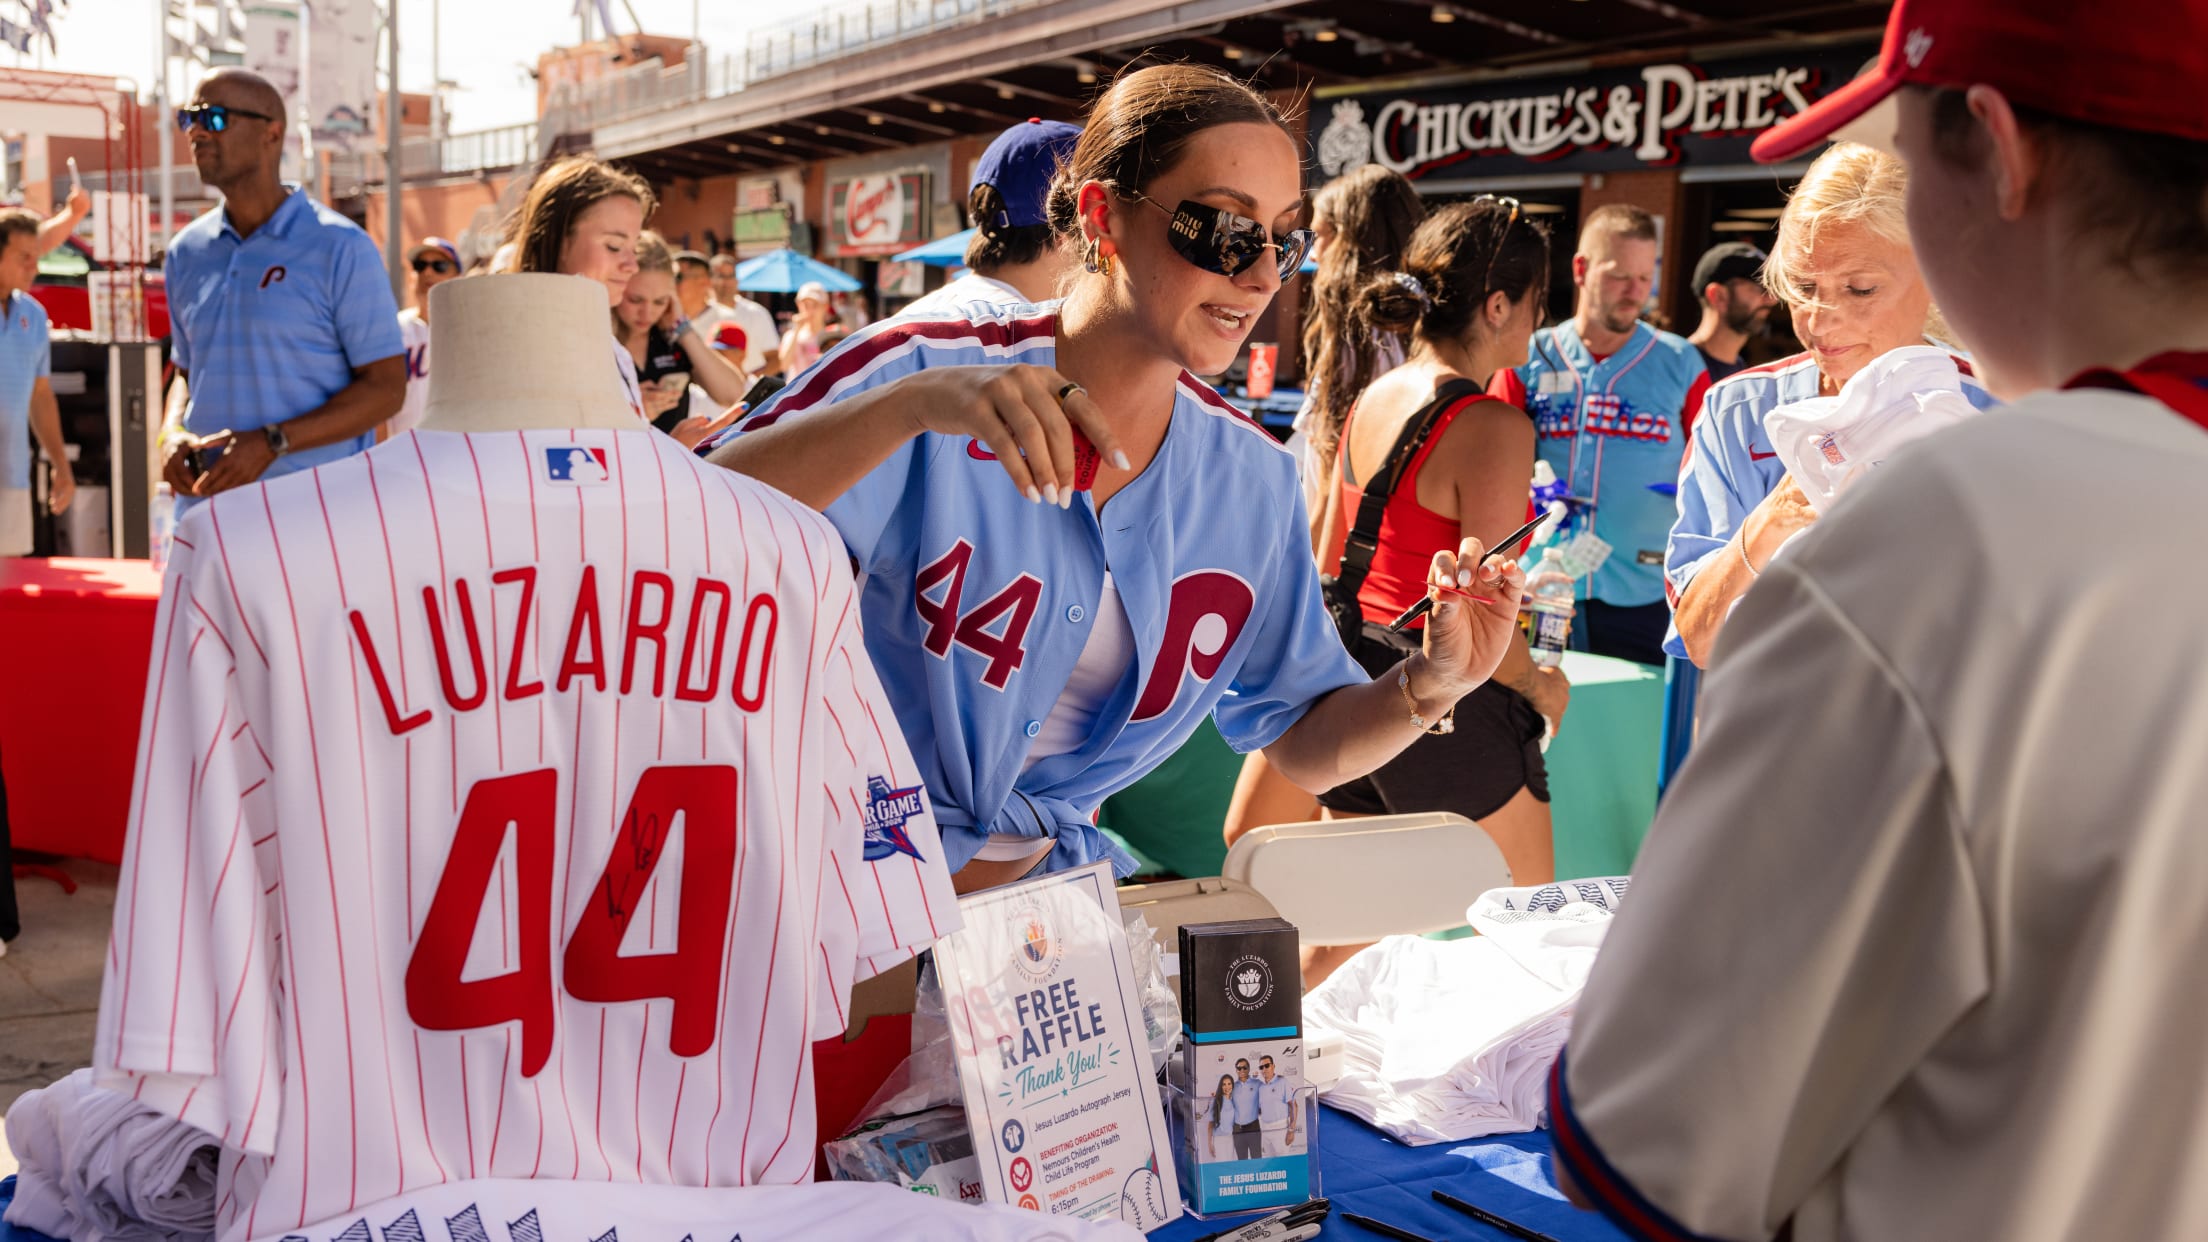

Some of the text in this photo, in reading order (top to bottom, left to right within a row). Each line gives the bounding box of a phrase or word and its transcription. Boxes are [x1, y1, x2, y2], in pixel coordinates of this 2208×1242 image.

[1602, 85, 1642, 147] &
[915, 533, 1044, 692] 44
[349, 564, 779, 736] LUZARDO
[1129, 568, 1256, 724] P
[876, 793, 920, 821] GAME
[405, 764, 738, 1079] 44
[1229, 954, 1269, 970] THE LUZARDO
[1014, 978, 1080, 1026] FREE
[1224, 984, 1275, 1011] FAMILY FOUNDATION
[997, 1003, 1106, 1070] RAFFLE
[1016, 1042, 1102, 1099] Thank You!
[1034, 1088, 1131, 1133] Jesus Luzardo Autograph Jersey
[1040, 1122, 1119, 1160] BENEFITING ORGANIZATION:
[1042, 1134, 1121, 1173] Nemours Children's Health
[1045, 1155, 1100, 1184] Child Life Program
[1049, 1167, 1115, 1201] TIMING OF THE DRAWING:
[1219, 1170, 1287, 1185] THE JESUS LUZARDO
[1051, 1196, 1079, 1215] 6:15pm
[1219, 1182, 1288, 1197] FAMILY FOUNDATION
